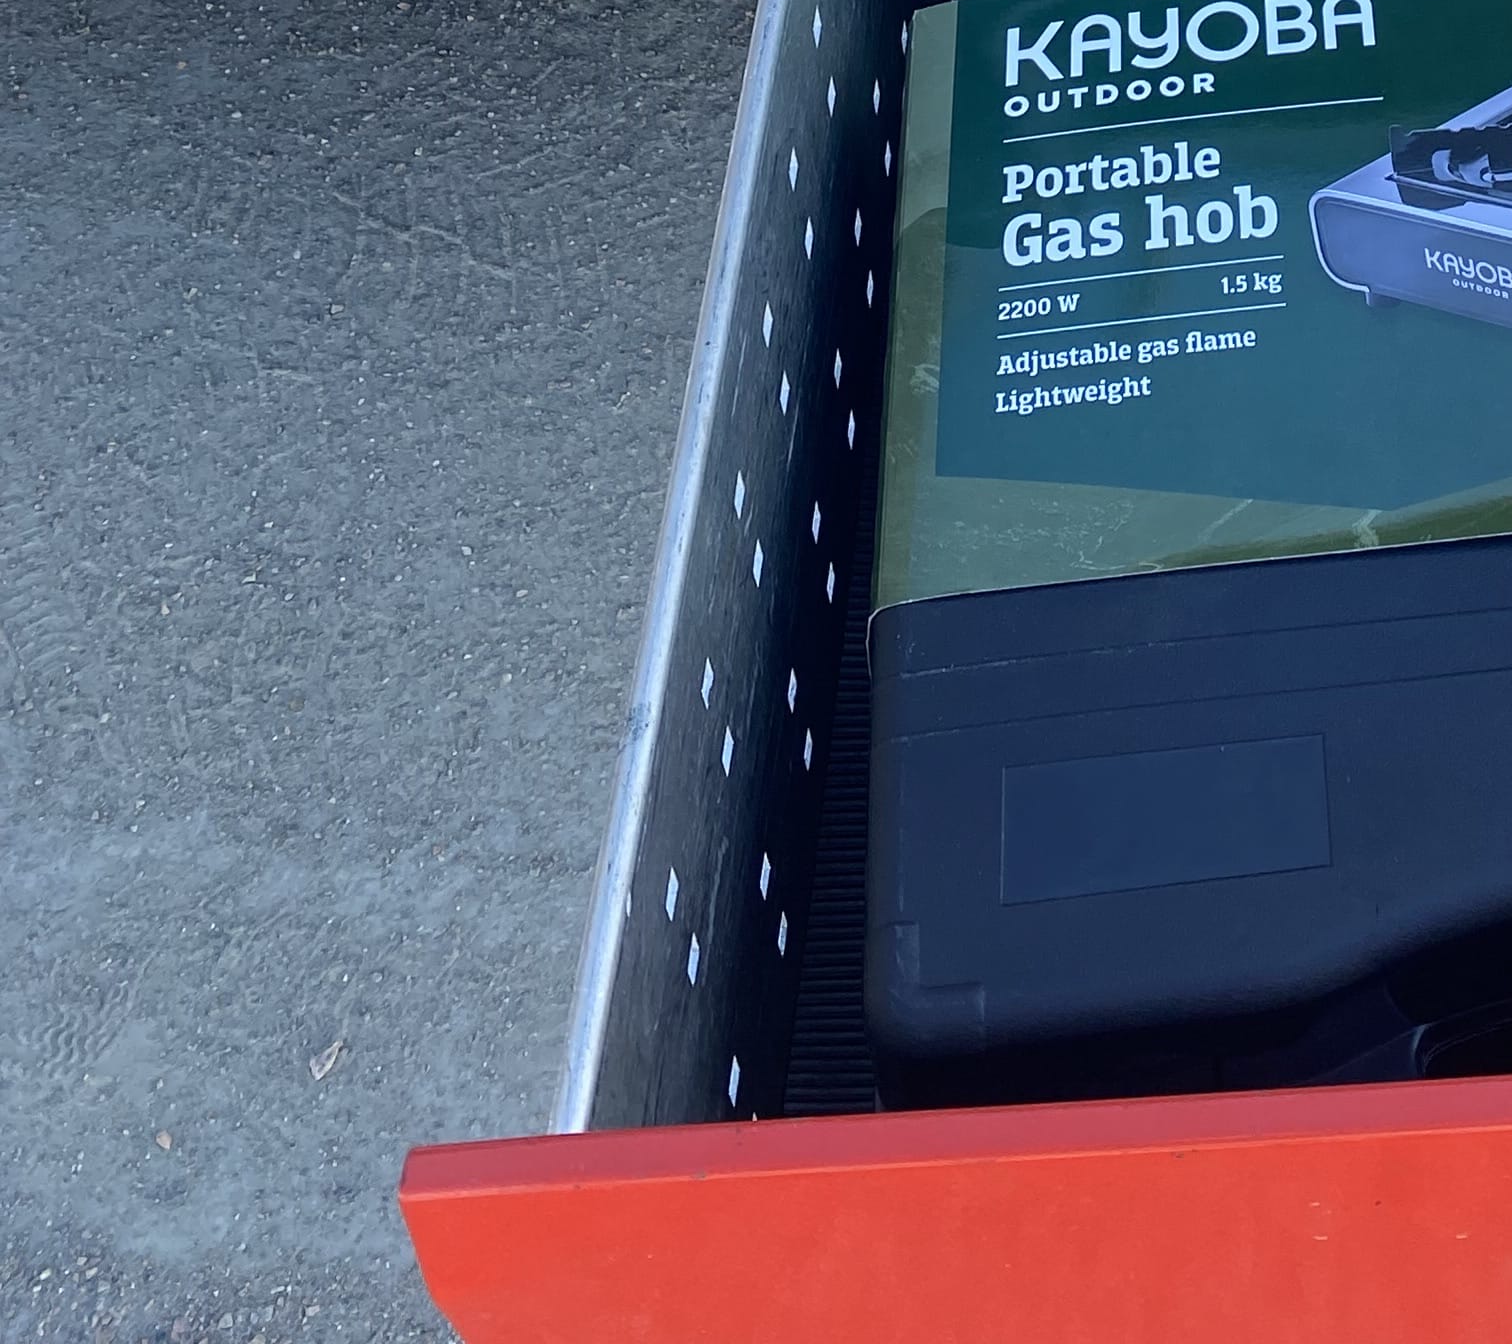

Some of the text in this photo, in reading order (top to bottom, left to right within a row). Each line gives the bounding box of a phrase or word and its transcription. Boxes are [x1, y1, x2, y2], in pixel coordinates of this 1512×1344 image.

[1003, 72, 1216, 117] OUTDOOR
[1001, 141, 1221, 204] Portable
[1002, 184, 1279, 266] Gas hob
[1220, 272, 1283, 294] 1.5 kg
[1452, 278, 1509, 299] OUTDOOR
[998, 293, 1081, 321] 2200 W
[997, 330, 1257, 376] Adjustable gas flame
[995, 375, 1151, 415] Lightweight
